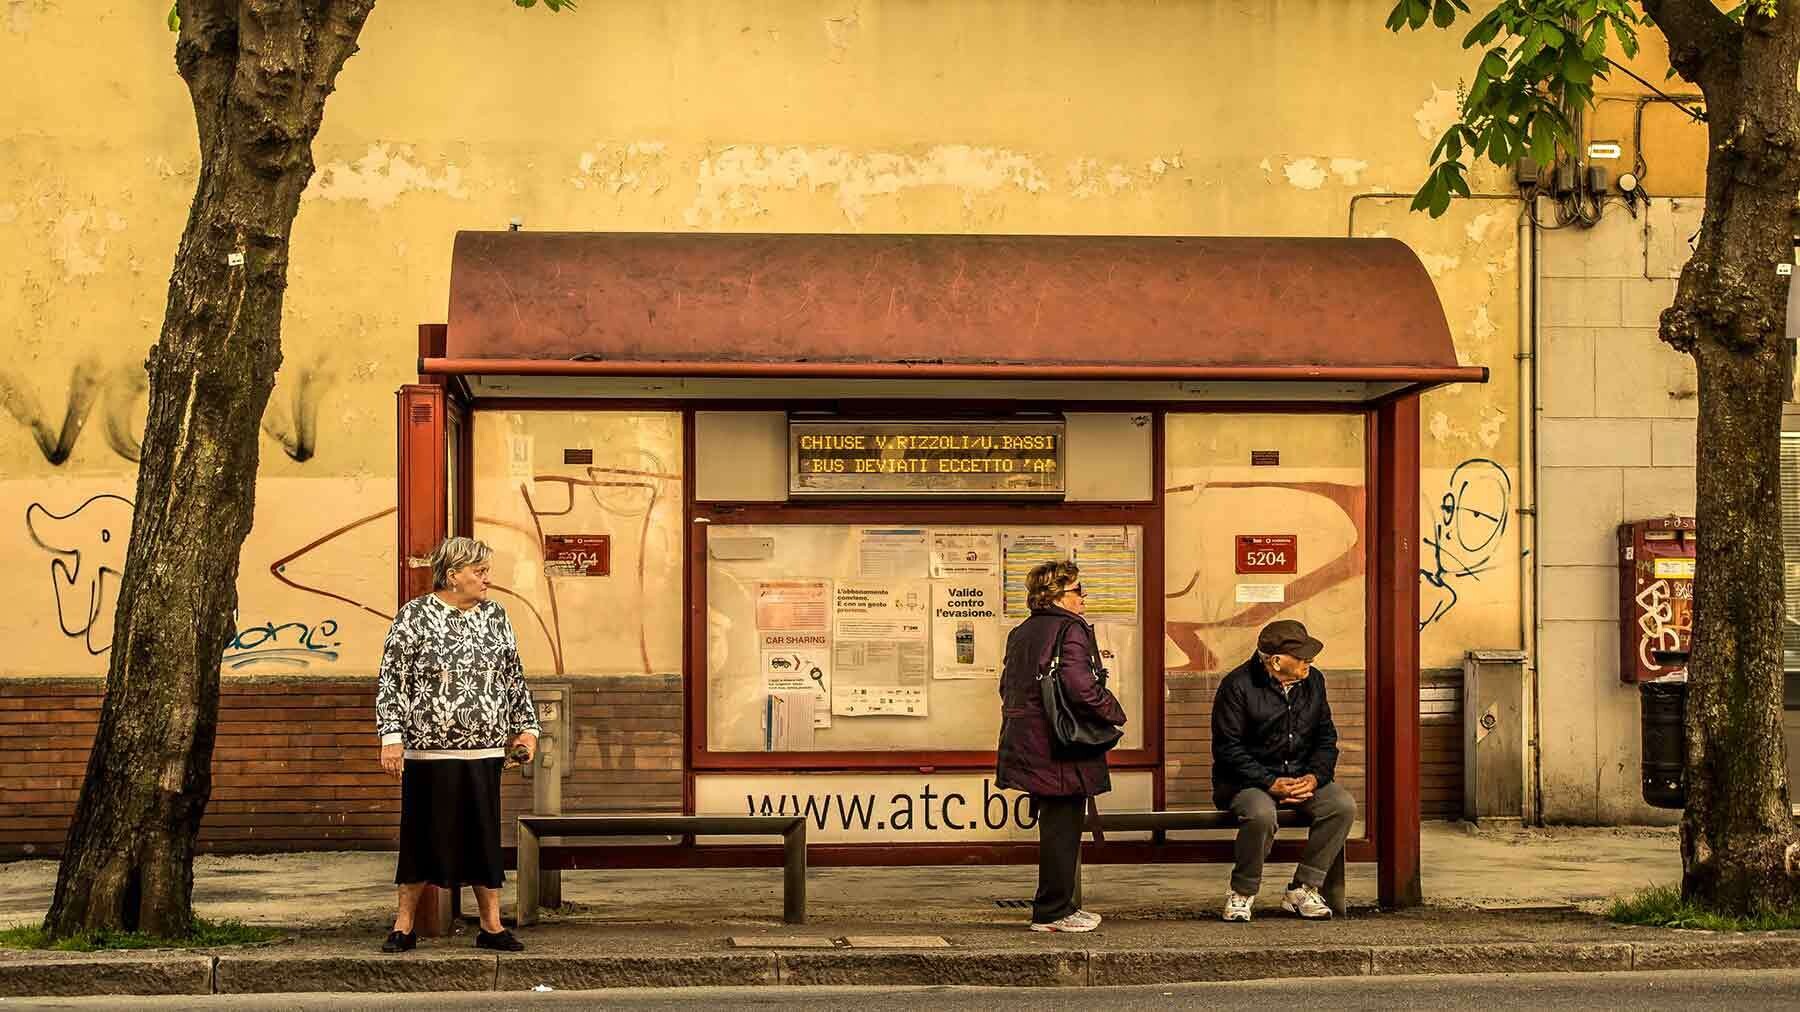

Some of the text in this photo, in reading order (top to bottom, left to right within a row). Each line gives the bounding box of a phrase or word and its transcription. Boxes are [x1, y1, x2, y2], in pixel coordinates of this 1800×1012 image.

[801, 435, 865, 450] CHIUSE
[812, 458, 845, 473] BUS
[855, 458, 928, 473] DEVIATI
[939, 458, 1013, 473] ECCETTO
[1247, 551, 1287, 566] 5204
[947, 588, 984, 597] Valido
[947, 598, 985, 608] contro
[936, 608, 996, 618] l'evasione.
[766, 636, 826, 645] CAR SHARING
[746, 778, 1039, 831] www.atc.bo
